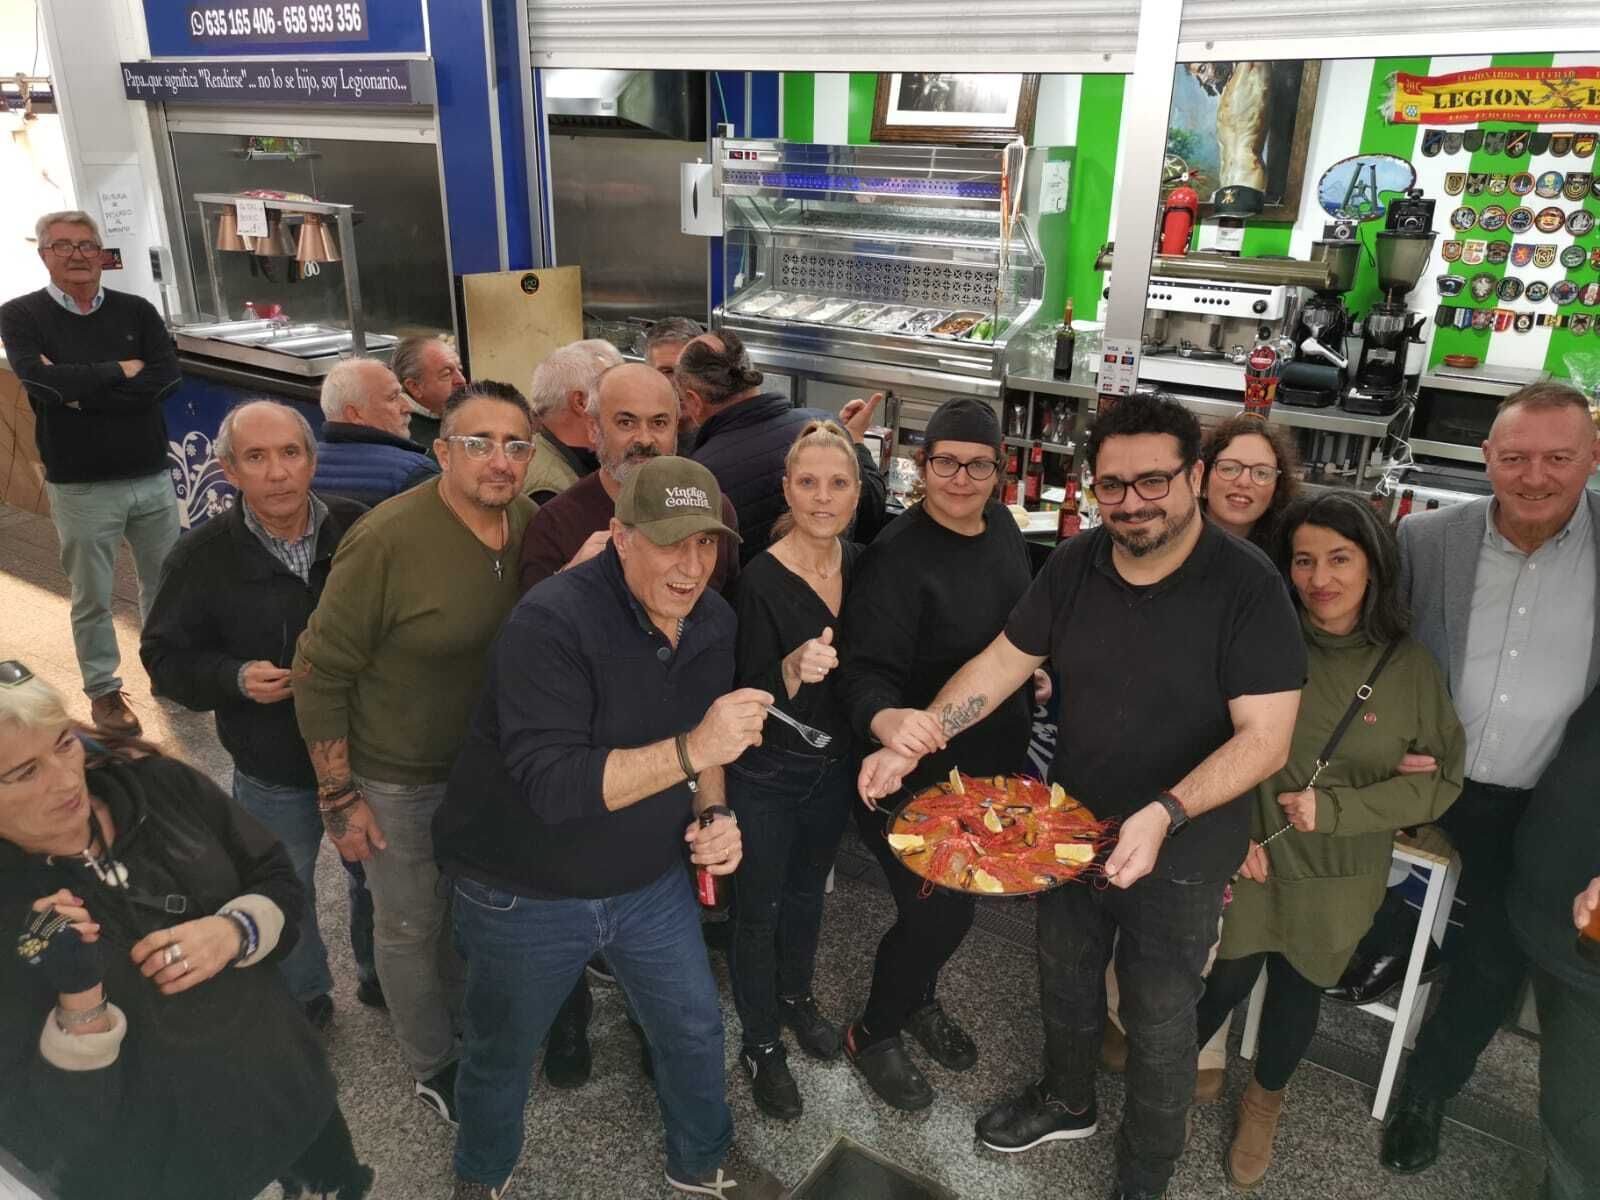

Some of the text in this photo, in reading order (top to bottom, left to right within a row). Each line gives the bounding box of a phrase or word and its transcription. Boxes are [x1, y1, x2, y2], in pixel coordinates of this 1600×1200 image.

[205, 9, 227, 35] 635
[228, 8, 251, 35] 165
[253, 7, 275, 34] 406
[283, 6, 307, 33] 658
[308, 4, 334, 32] 993
[335, 3, 362, 31] 356
[164, 68, 199, 94] significa
[258, 75, 271, 88] no
[271, 67, 283, 88] lo
[285, 75, 295, 88] se
[296, 67, 319, 96] hijo,
[322, 75, 338, 97] soy
[1434, 88, 1532, 109] LEGION
